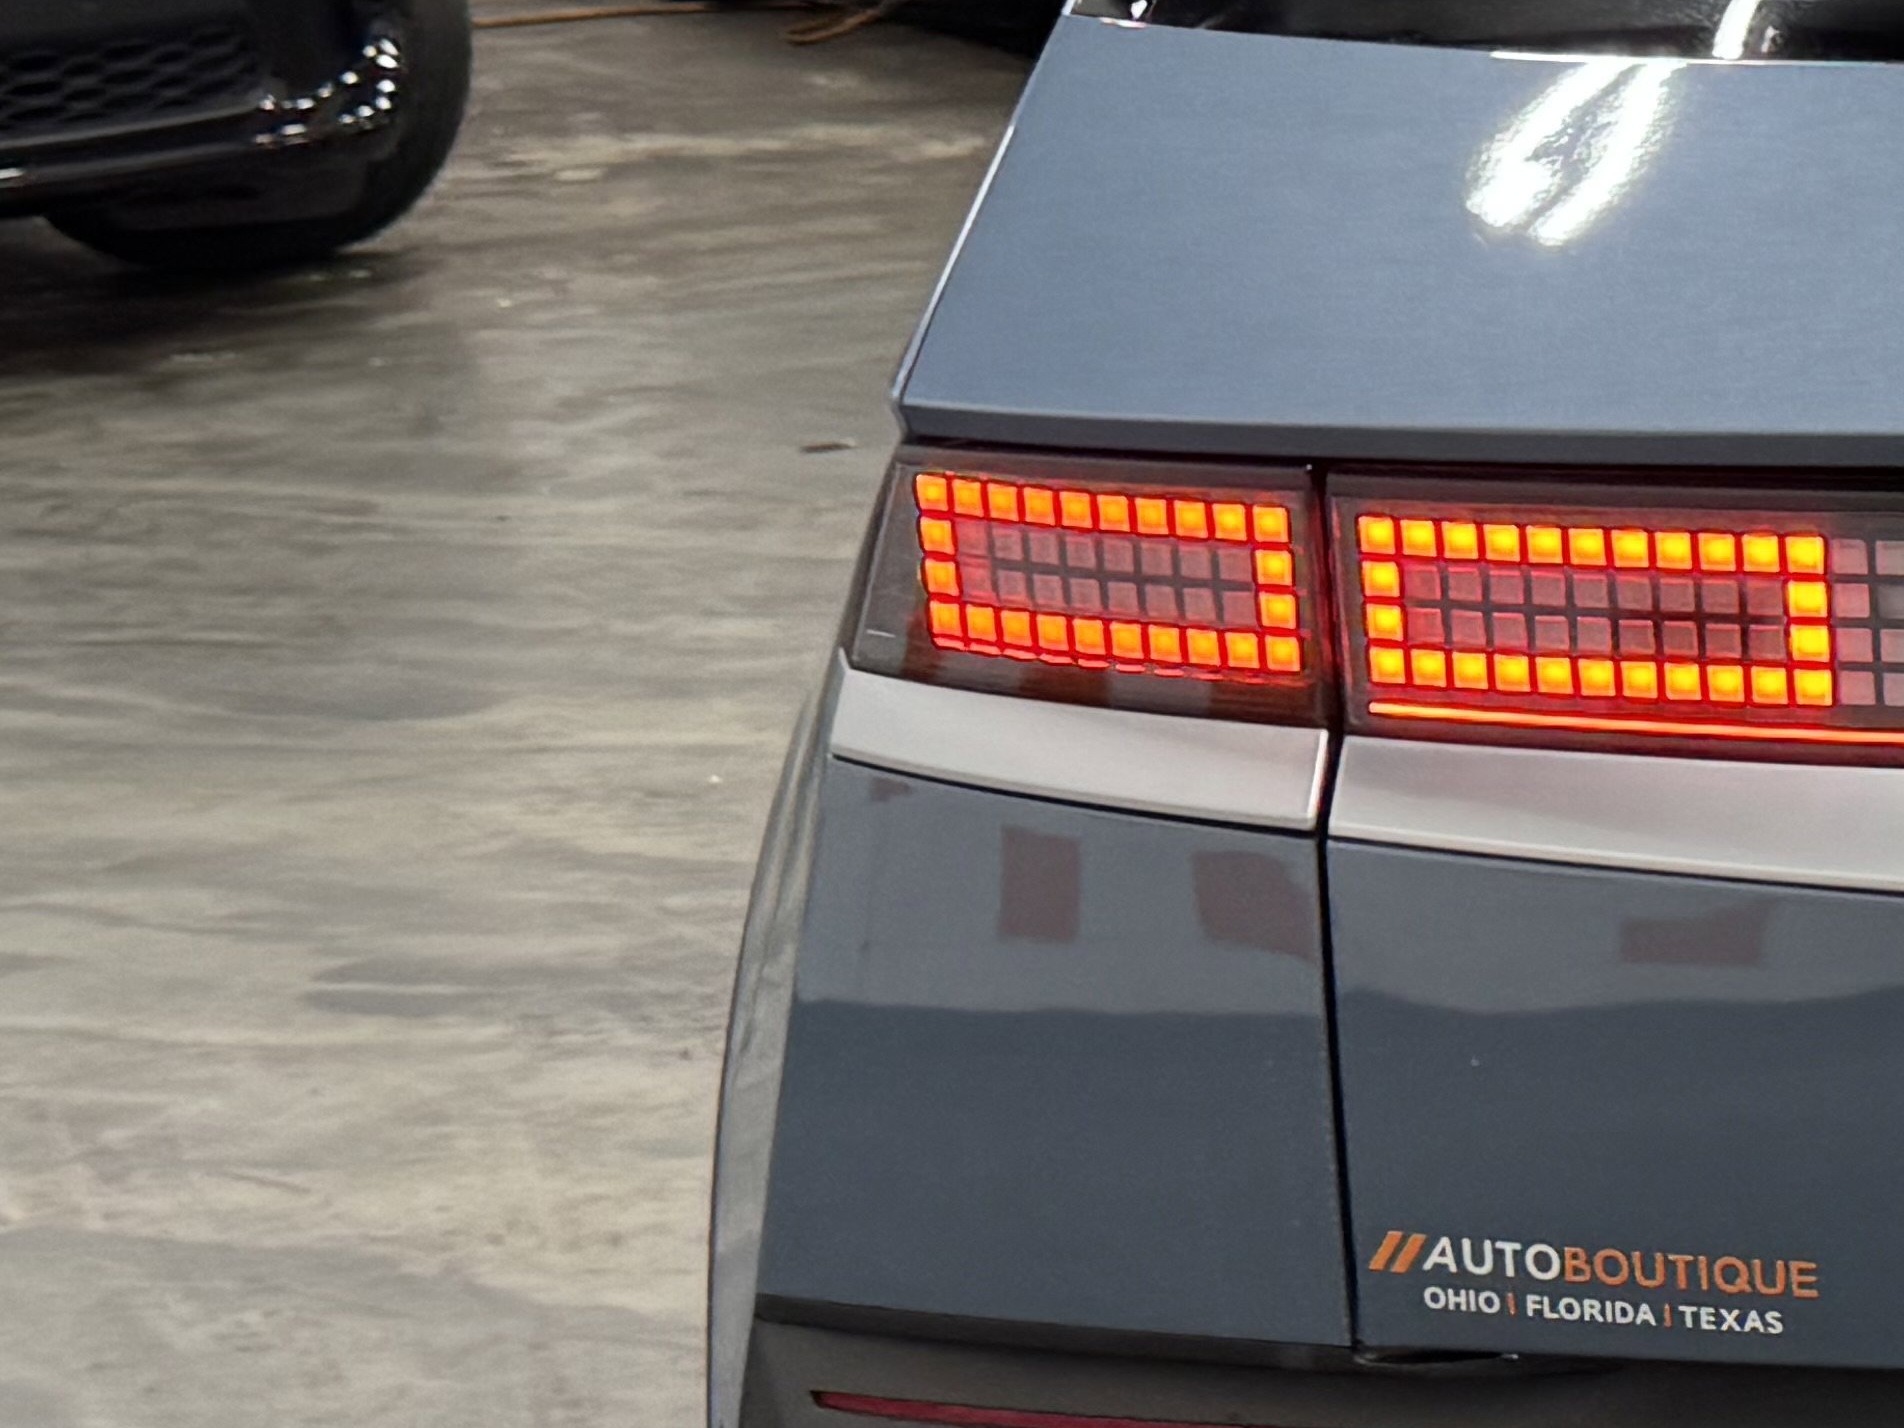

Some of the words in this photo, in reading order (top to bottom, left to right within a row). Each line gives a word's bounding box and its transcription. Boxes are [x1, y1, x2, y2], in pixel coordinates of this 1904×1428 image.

[1423, 1235, 1820, 1299] AUTOBOUTIQUE
[1424, 1286, 1500, 1314] OHIO
[1526, 1294, 1656, 1327] FLORIDA
[1679, 1305, 1784, 1335] TEXAS
